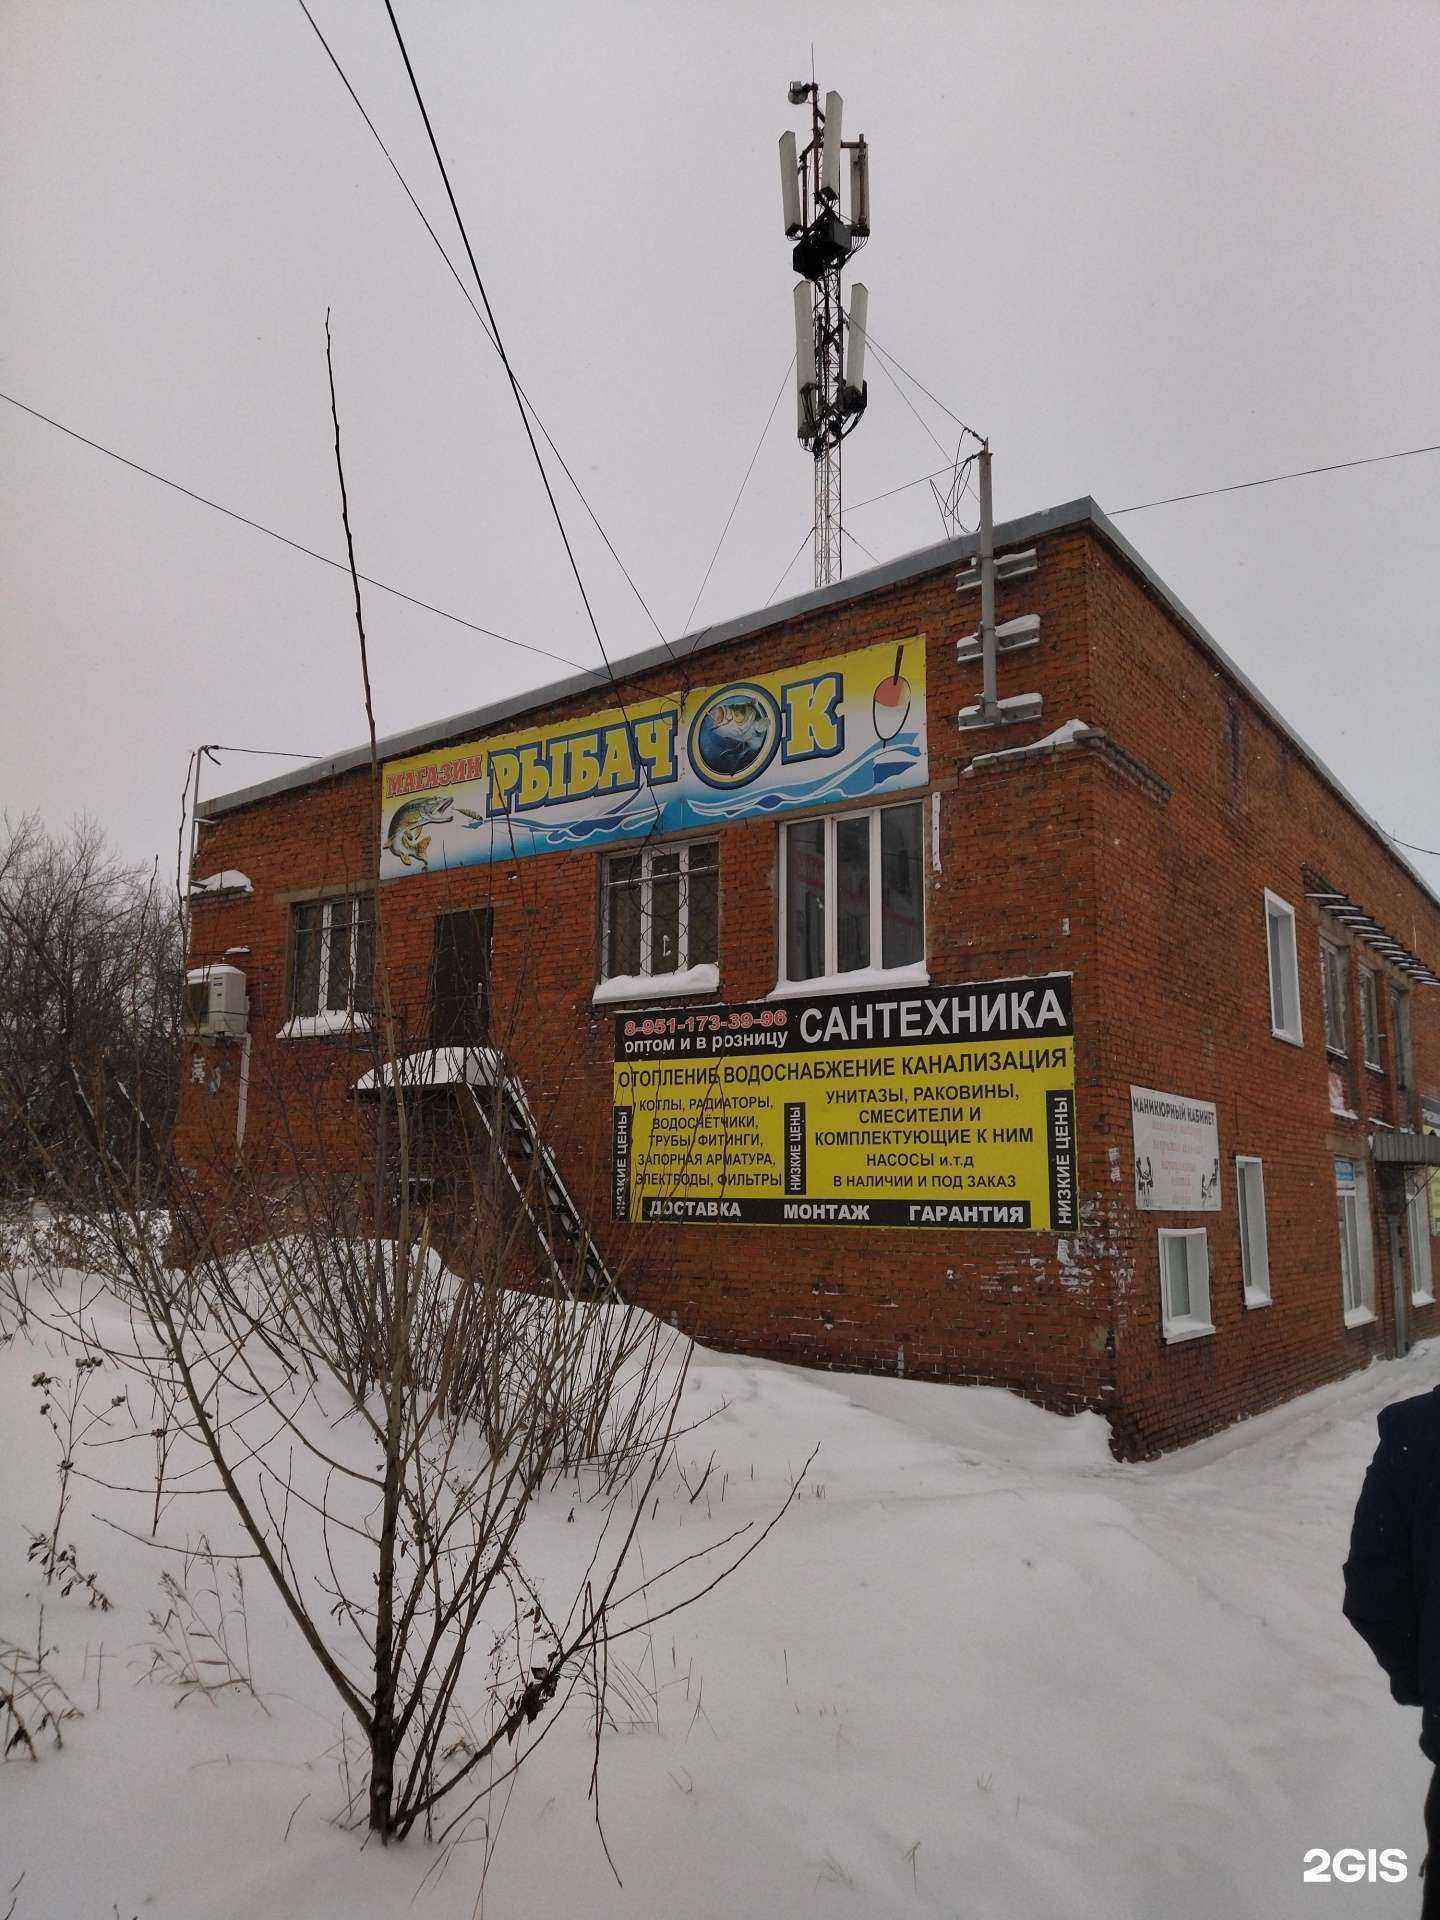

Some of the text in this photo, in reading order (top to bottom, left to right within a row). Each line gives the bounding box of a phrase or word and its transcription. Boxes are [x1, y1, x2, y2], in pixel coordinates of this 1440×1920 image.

[486, 671, 844, 816] РЫБАЧОК
[386, 755, 482, 799] МАГАЗИН
[800, 989, 1067, 1044] САНТЕХНИКА
[625, 1030, 788, 1054] оптом и в розницу
[619, 1048, 1067, 1088] ОТОПЛЕНИЕ ВОДОСНАБЖЕНИЕ КАНАЛИЗАЦИЯ
[639, 1095, 774, 1112] КОТЛЫ, РАДИАТОРЫ,
[826, 1083, 1020, 1104] УНИТАЗЫ, РАКОВИНЫ,
[859, 1107, 981, 1124] СМЕСИТЕЛИ И
[1133, 1097, 1215, 1126] МАНИКЮРНЫЙ КАБИНЕТ
[698, 1133, 764, 1147] ФИТИНГИ,
[790, 1107, 802, 1191] НИЗКИЕ ЦЕНЫ
[815, 1128, 1034, 1147] КОМПЛЕКТУЮЩИЕ К НИМ
[616, 1111, 629, 1216] НИЗКИЕ ЦЕНЫ
[638, 1152, 776, 1167] ЗАПОРНАЯ АРМАТУРА,
[866, 1153, 934, 1167] НАСОСЫ
[1054, 1096, 1073, 1225] НИЗКИЕ ЦЕНЫ
[636, 1173, 783, 1187] ЭЛЕКТРОДЫ, ФИЛЬТРЫ
[833, 1175, 1017, 1190] В НАЛИЧИИ И ПОД ЗАКАЗ
[649, 1200, 1024, 1223] ДОСТАВКА МОНТАЖ ГАРАНТИЯ
